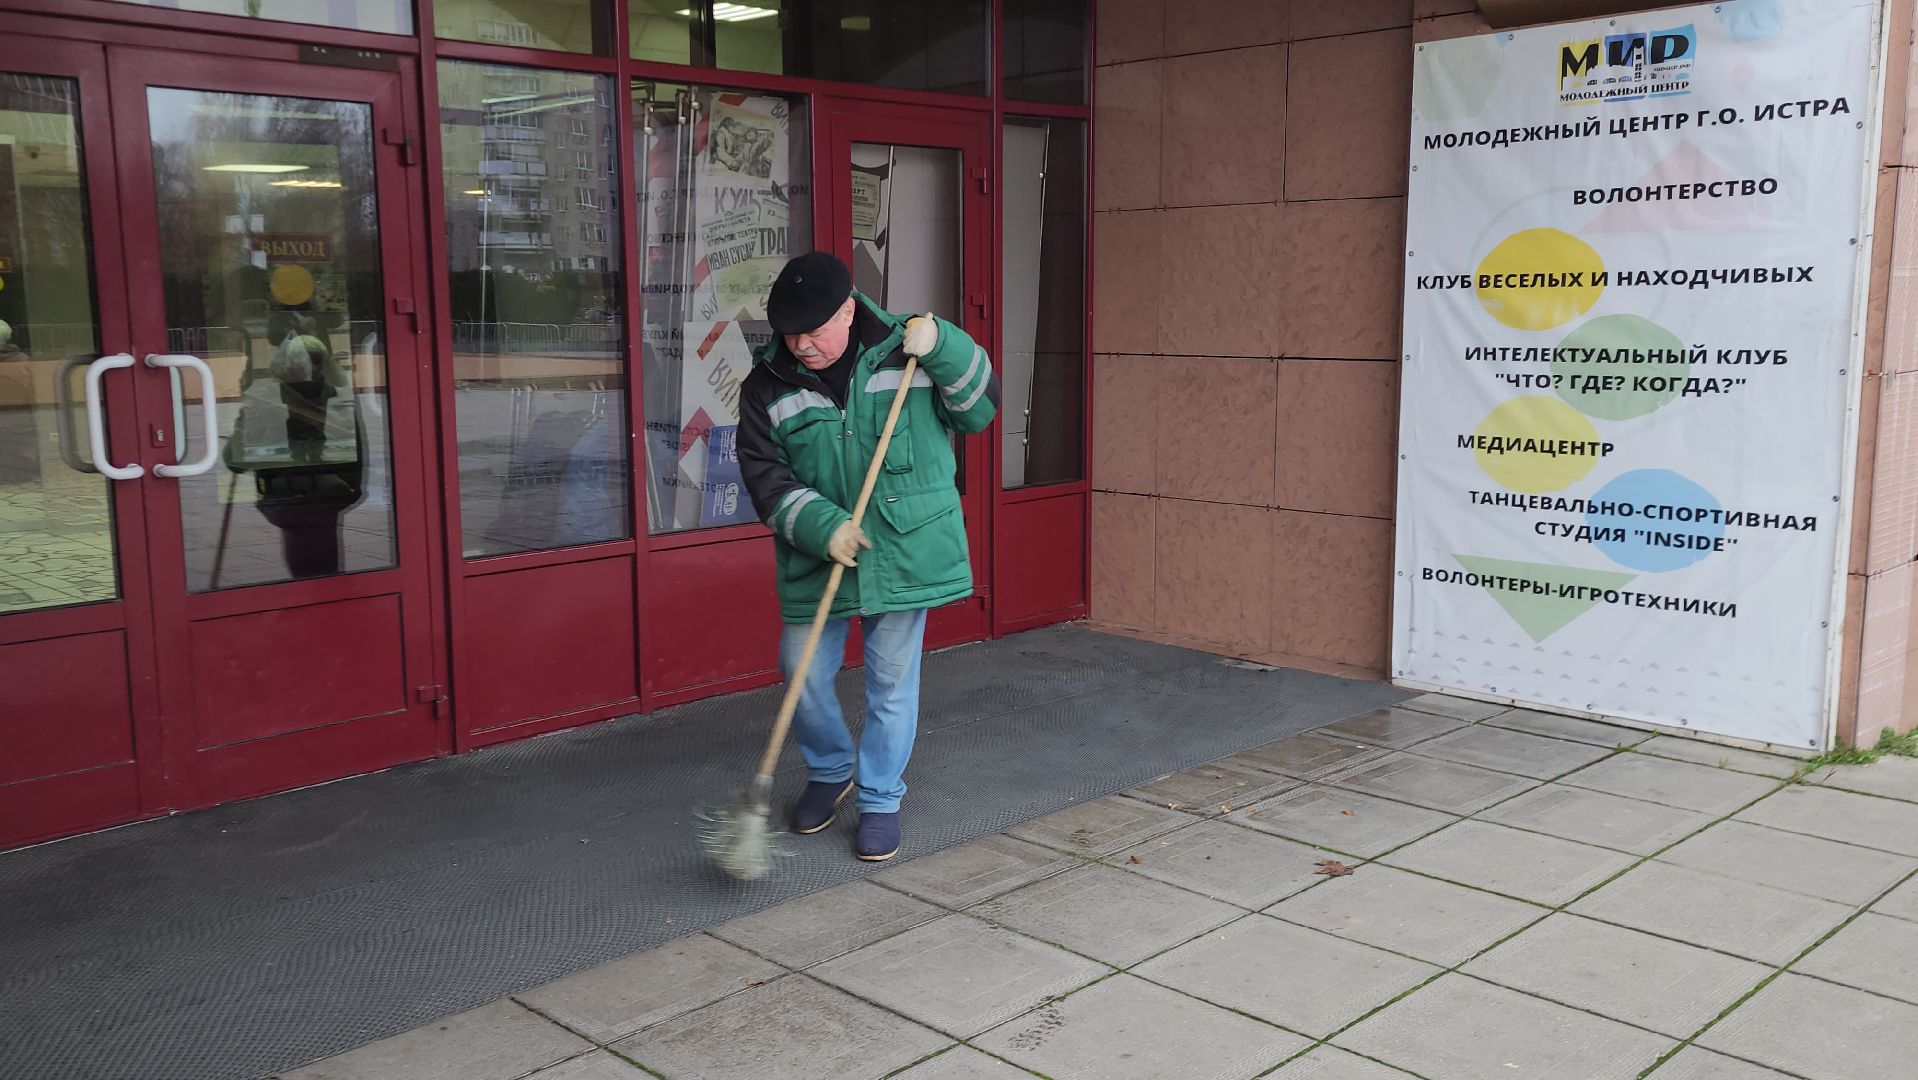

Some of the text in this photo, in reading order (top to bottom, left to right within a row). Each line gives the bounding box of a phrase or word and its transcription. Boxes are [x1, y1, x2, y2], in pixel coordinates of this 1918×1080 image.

[1560, 34, 1690, 92] МИР
[1559, 80, 1690, 102] МОЛОДЕЖНЫЙ ЦЕНТР
[1424, 97, 1850, 150] МОЛОДЕЖНЫЙ ЦЕНТР Г.О. ИСТРА
[1573, 177, 1778, 205] ВОЛОНТЕРСТВО
[260, 240, 325, 256] ВЫХОД
[1417, 266, 1814, 290] КЛУБ ВЕСЕЛЫХ И НАХОДЧИВЫХ
[1465, 344, 1788, 365] ИНТЕЛЕКТУАЛЬНЫЙ КЛУБ
[1495, 373, 1746, 398] "ЧТО? ГДЕ? КОГДА?"
[1457, 434, 1614, 458] МЕДИАЦЕНТР
[1468, 490, 1817, 532] ТАНЦЕВАЛЬНО-СПОРТИВНАЯ
[1534, 521, 1738, 552] СТУДИЯ "INSIDE"
[1422, 567, 1737, 618] ВОЛОНТЕРЫ-ИГРОТЕХНИКИ
